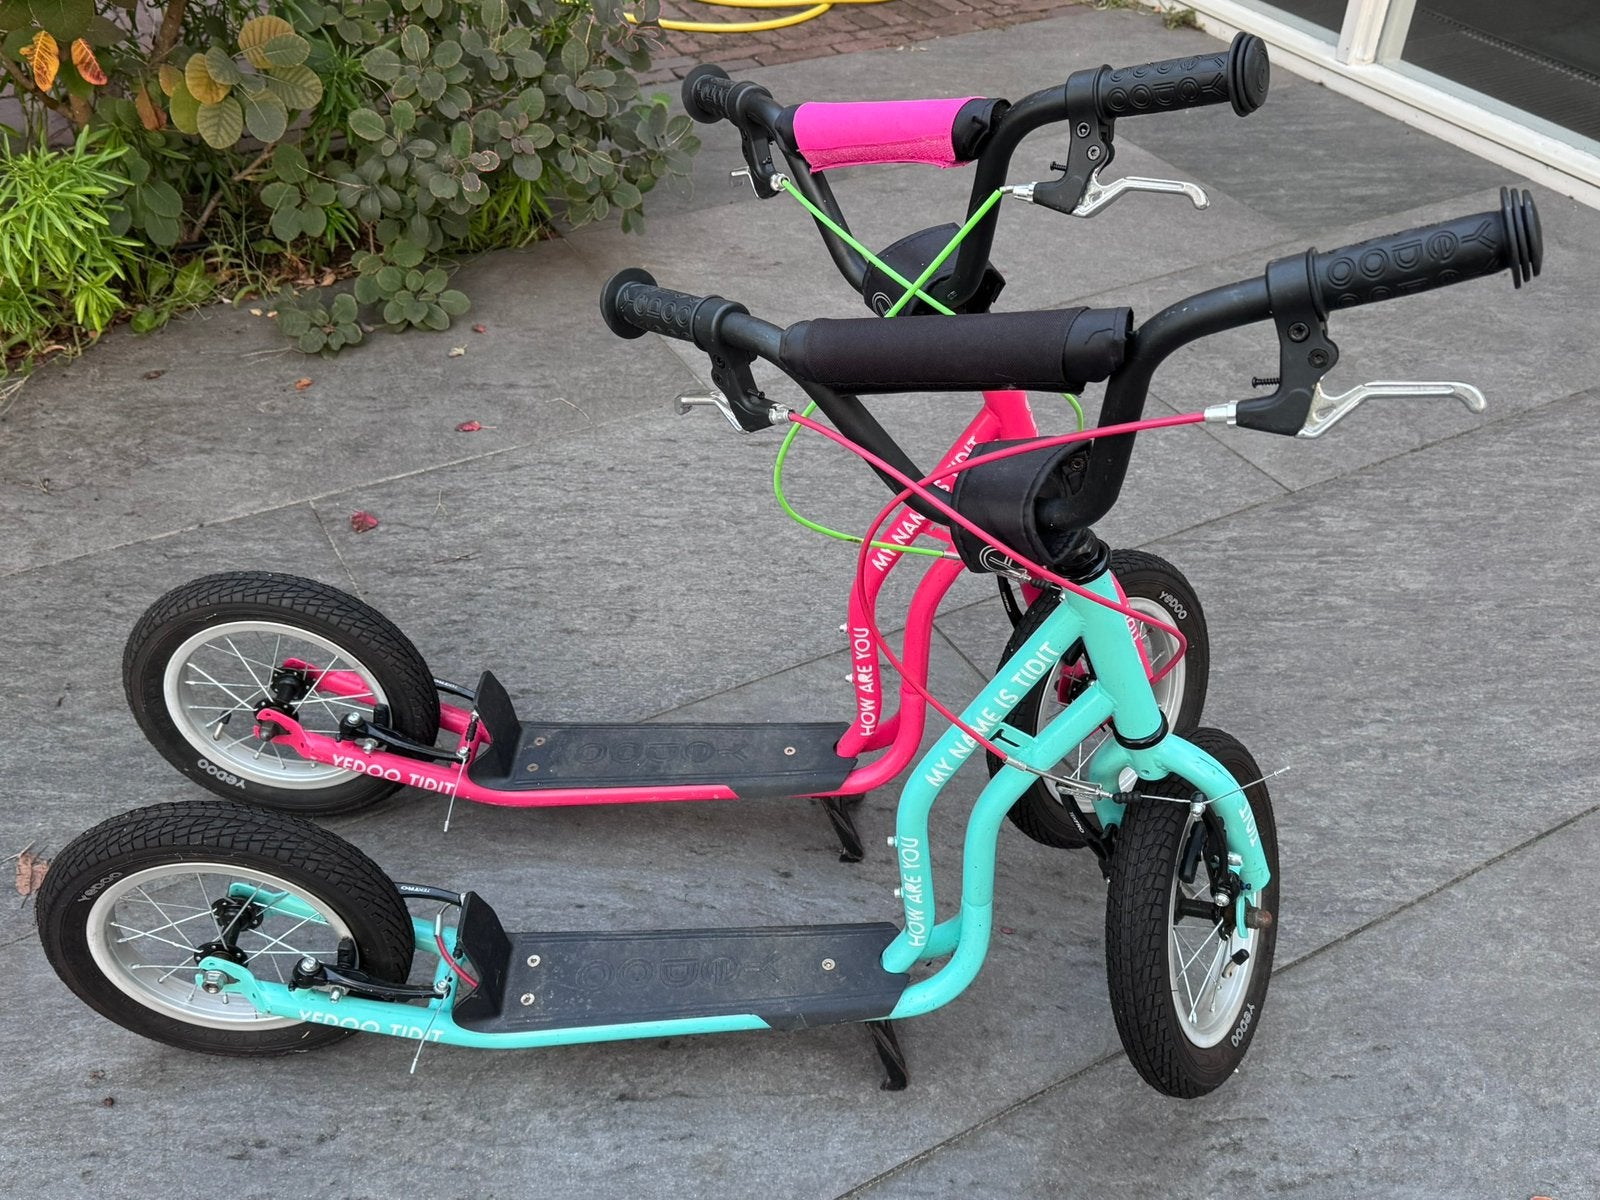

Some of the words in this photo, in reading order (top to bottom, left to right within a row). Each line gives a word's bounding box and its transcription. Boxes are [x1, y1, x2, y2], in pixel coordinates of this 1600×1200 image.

[853, 627, 871, 660] YOU
[856, 664, 875, 693] ARE
[859, 697, 876, 737] HOW
[924, 757, 954, 787] MY
[949, 707, 1002, 759] NAME
[993, 688, 1019, 709] IS
[1011, 641, 1060, 687] TIDIT
[332, 754, 402, 782] YEDOO
[409, 773, 455, 794] TIDIT
[900, 836, 920, 869] YOU
[903, 873, 922, 904] ARE
[907, 906, 926, 947] HOW
